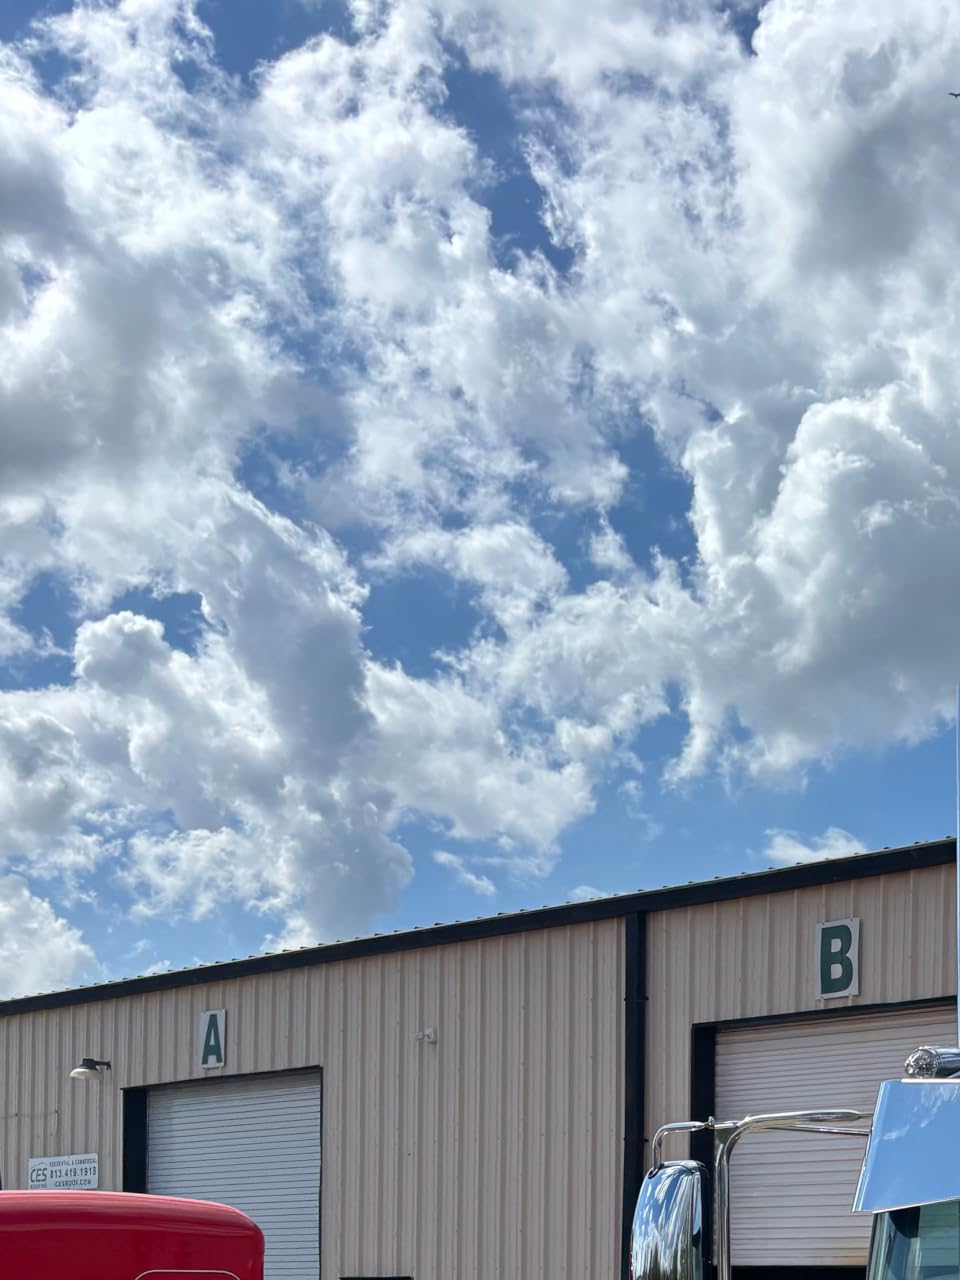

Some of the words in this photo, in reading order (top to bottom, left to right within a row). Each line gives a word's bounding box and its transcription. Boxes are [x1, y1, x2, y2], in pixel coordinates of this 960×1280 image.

[820, 924, 854, 995] B
[201, 1013, 223, 1065] A
[30, 1167, 48, 1183] CES
